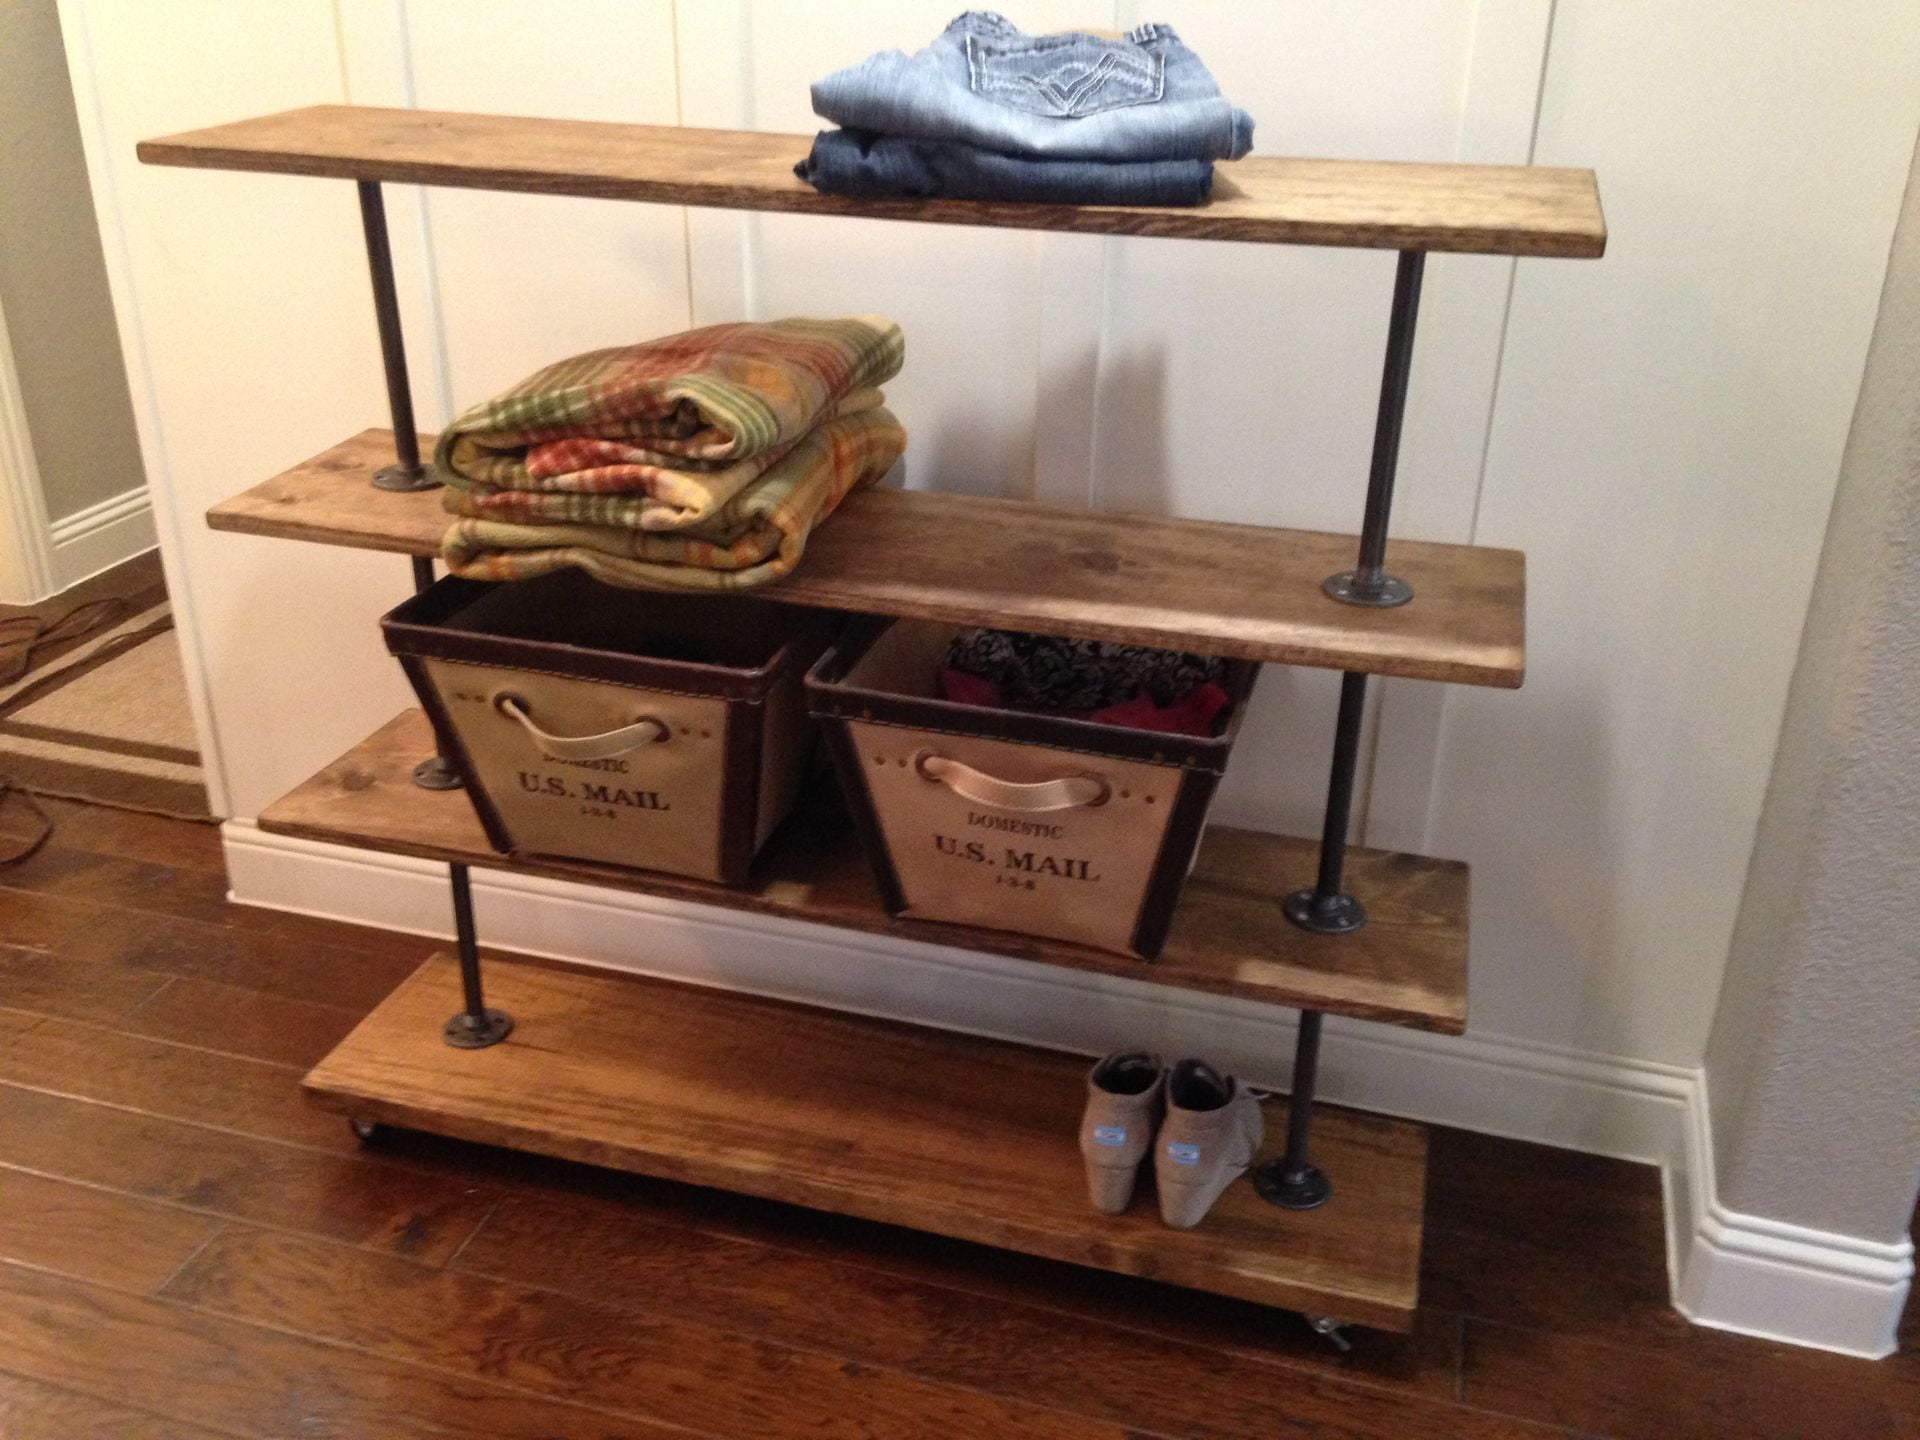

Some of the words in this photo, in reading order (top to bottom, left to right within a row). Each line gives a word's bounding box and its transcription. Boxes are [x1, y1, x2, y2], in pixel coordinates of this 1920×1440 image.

[517, 771, 576, 798] U.S.
[581, 782, 671, 811] MAIL
[967, 811, 1064, 840] DOMESTIC
[934, 834, 995, 866] U.S.
[1005, 848, 1101, 882] MAIL
